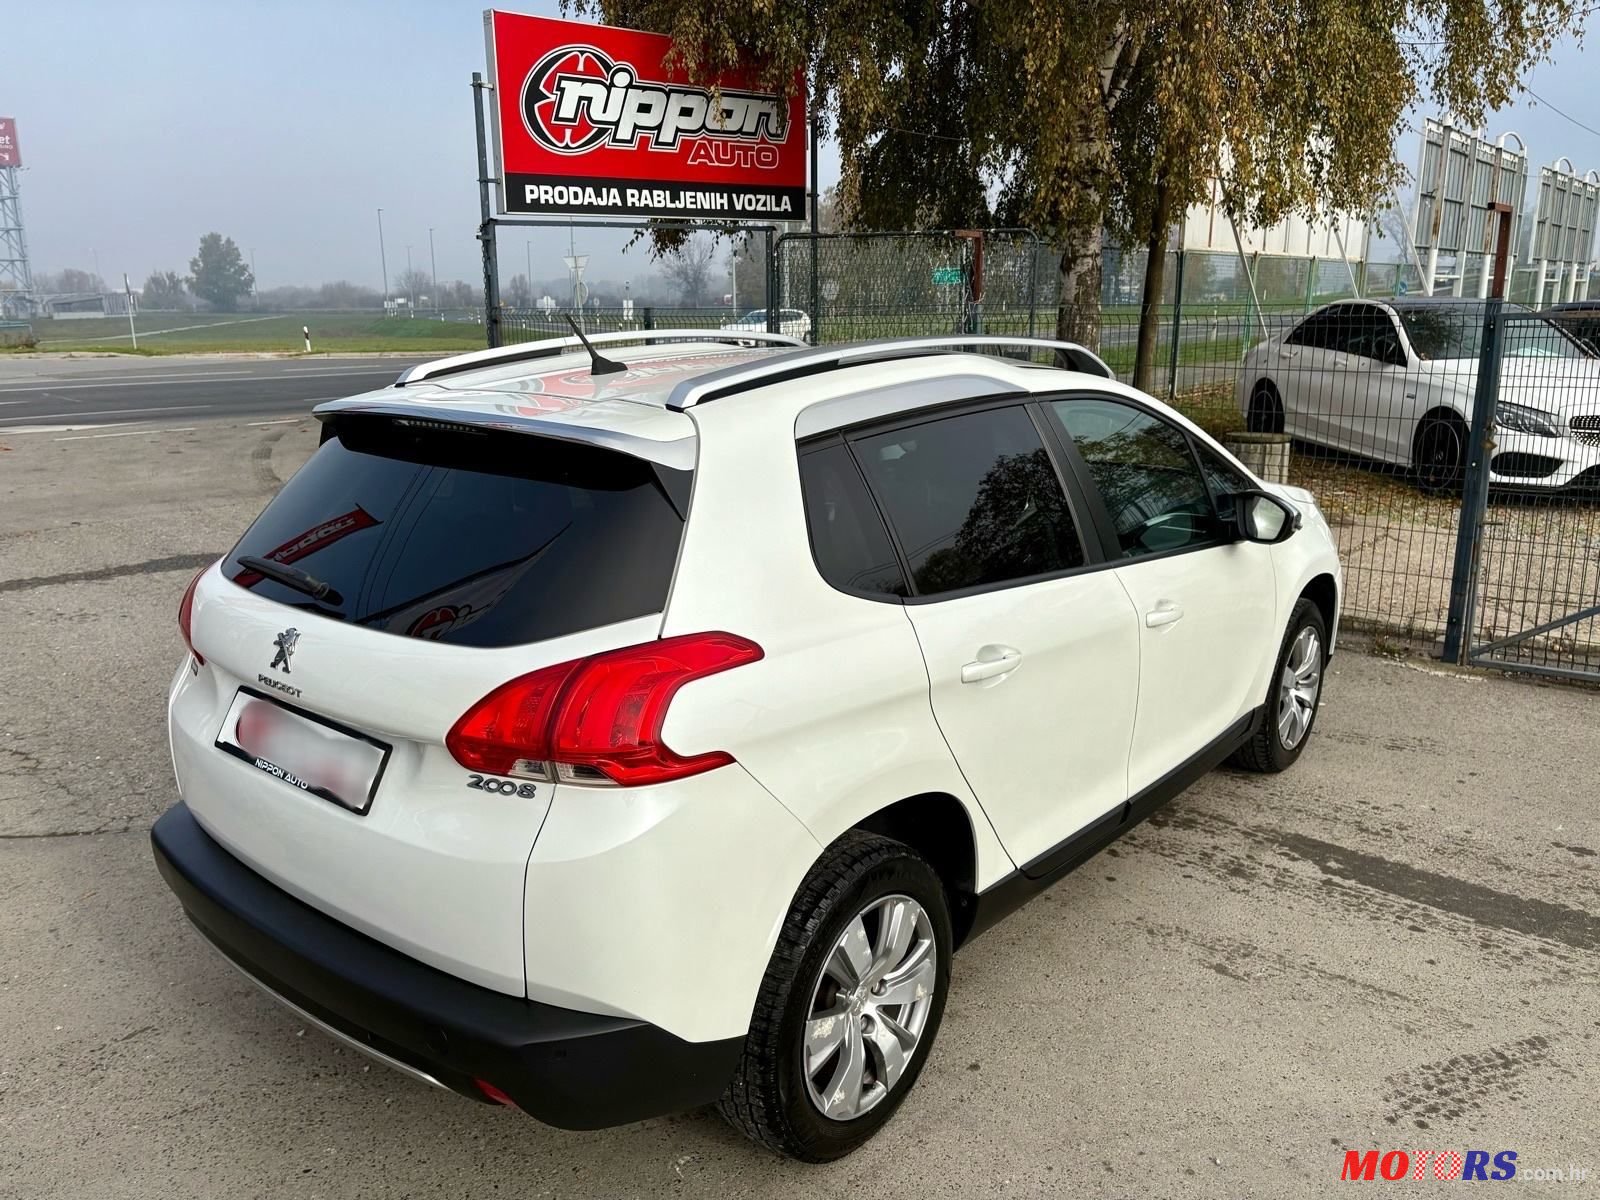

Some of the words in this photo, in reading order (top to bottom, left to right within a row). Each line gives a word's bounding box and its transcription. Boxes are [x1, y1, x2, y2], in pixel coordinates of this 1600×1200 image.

[687, 140, 780, 169] AUTO
[525, 184, 623, 208] PRODAJA
[626, 187, 729, 211] RABLJENIH
[731, 193, 792, 212] VOZILA
[257, 673, 303, 698] PEUGEOT
[254, 758, 285, 779] NIPPON
[284, 773, 309, 790] AUTO
[466, 773, 537, 799] 2008
